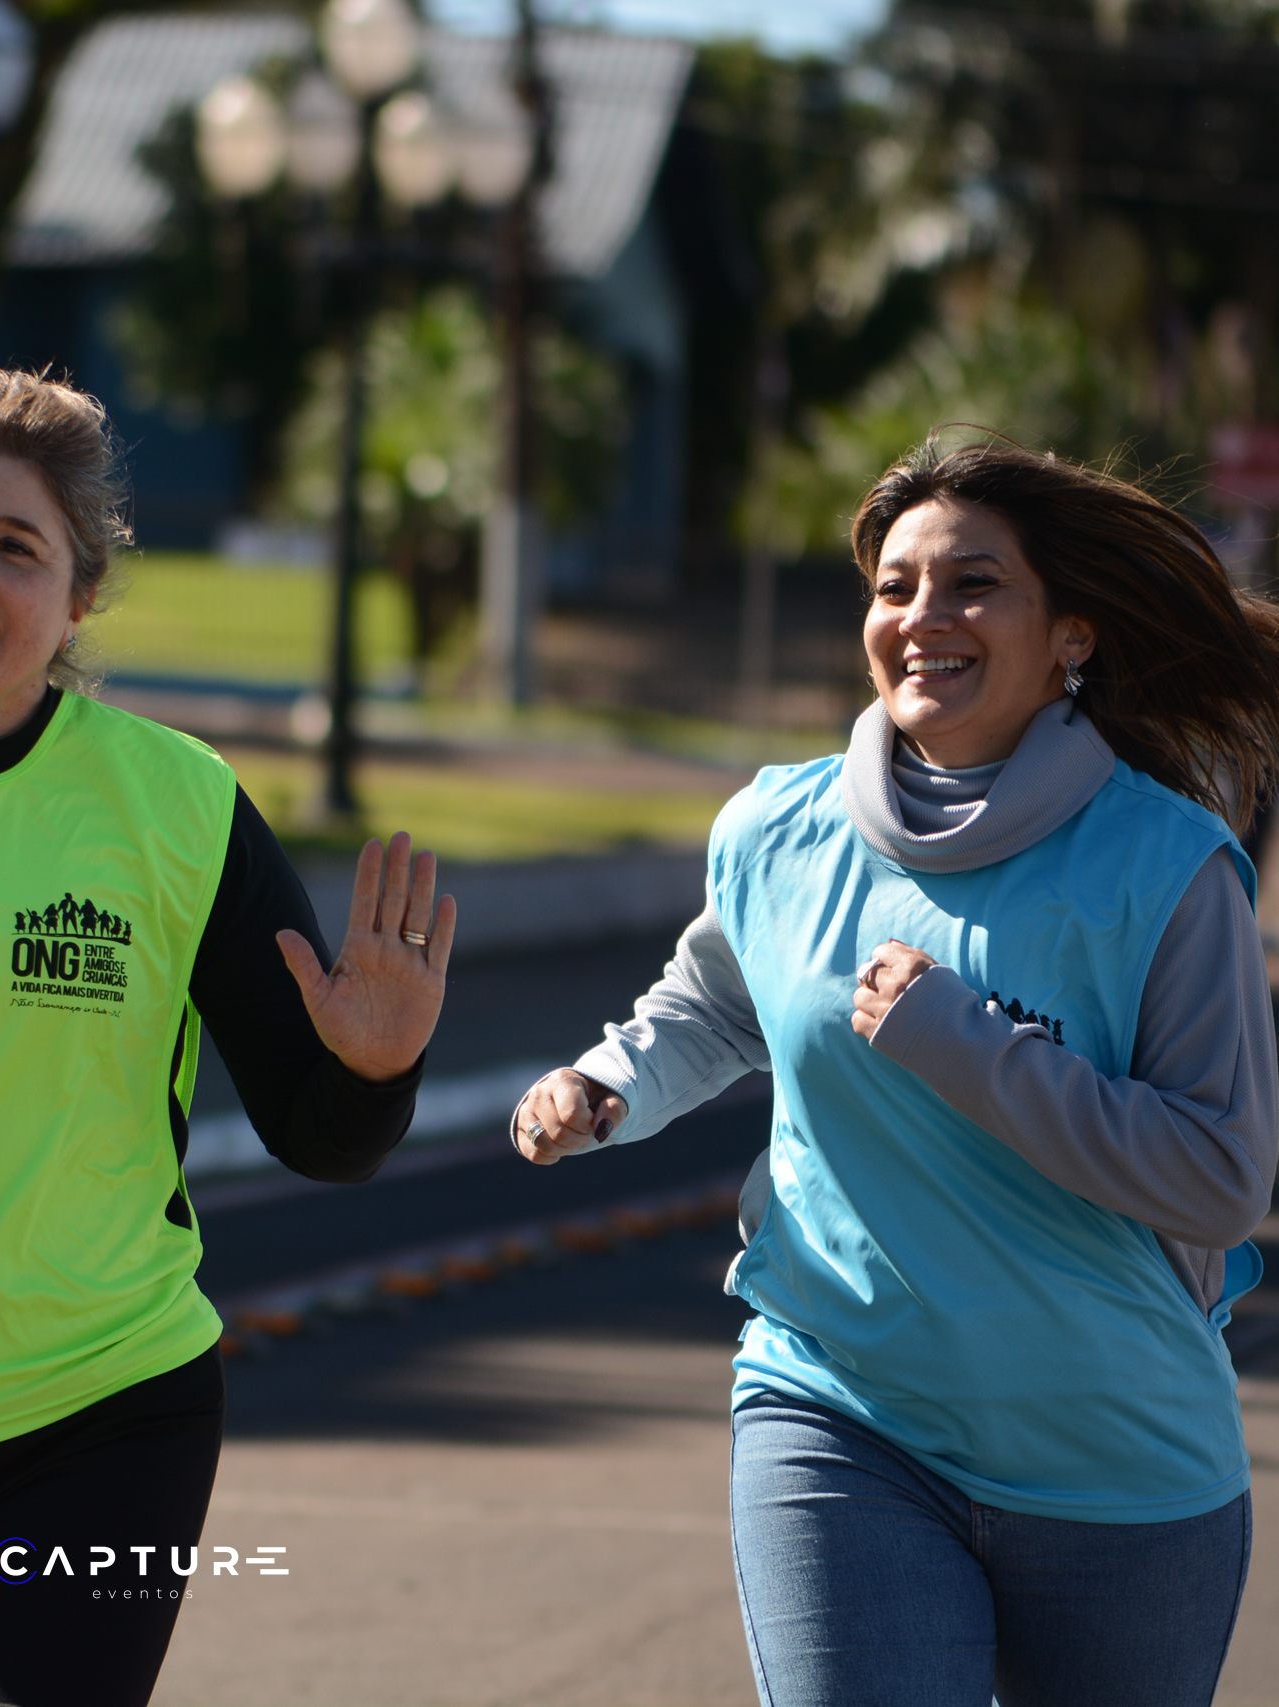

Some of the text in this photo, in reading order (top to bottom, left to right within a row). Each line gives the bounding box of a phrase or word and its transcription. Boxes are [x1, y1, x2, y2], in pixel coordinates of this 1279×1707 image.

[11, 937, 81, 981] ONG
[84, 943, 116, 959] ENTRE
[83, 957, 126, 974] AMIGOS E
[11, 981, 124, 1003] A VIDA FICA MAIS DIVERTIDA
